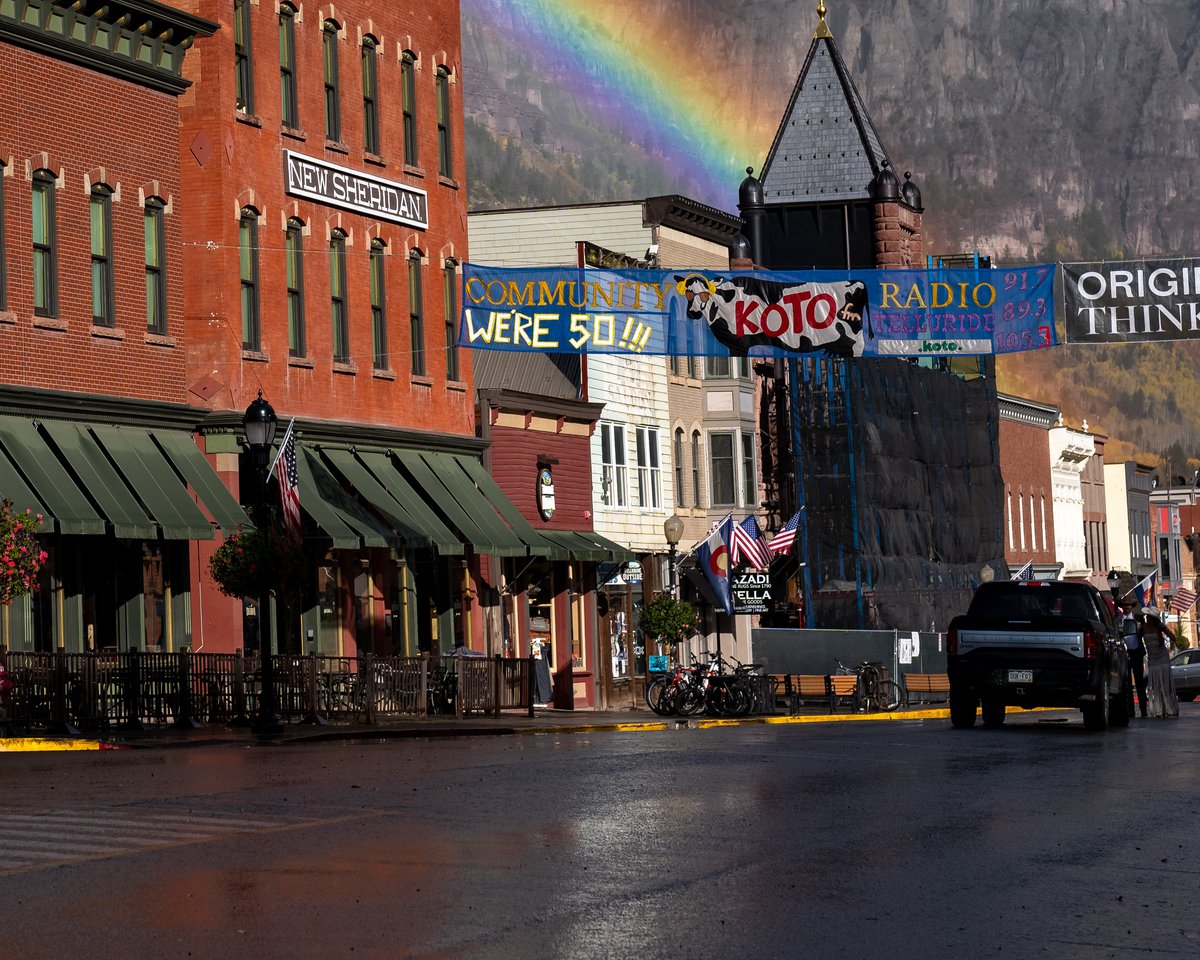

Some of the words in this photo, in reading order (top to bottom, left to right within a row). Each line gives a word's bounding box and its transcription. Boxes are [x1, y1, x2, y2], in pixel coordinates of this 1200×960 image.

[290, 159, 328, 195] NEW
[1004, 269, 1049, 291] 91.7
[465, 277, 674, 309] COMMUNITY
[879, 282, 997, 309] RADIO
[735, 291, 837, 338] KOTO
[841, 303, 862, 321] fm
[1002, 297, 1047, 321] 89.3
[872, 313, 996, 334] TELLURIDE
[735, 590, 772, 600] ELLA
